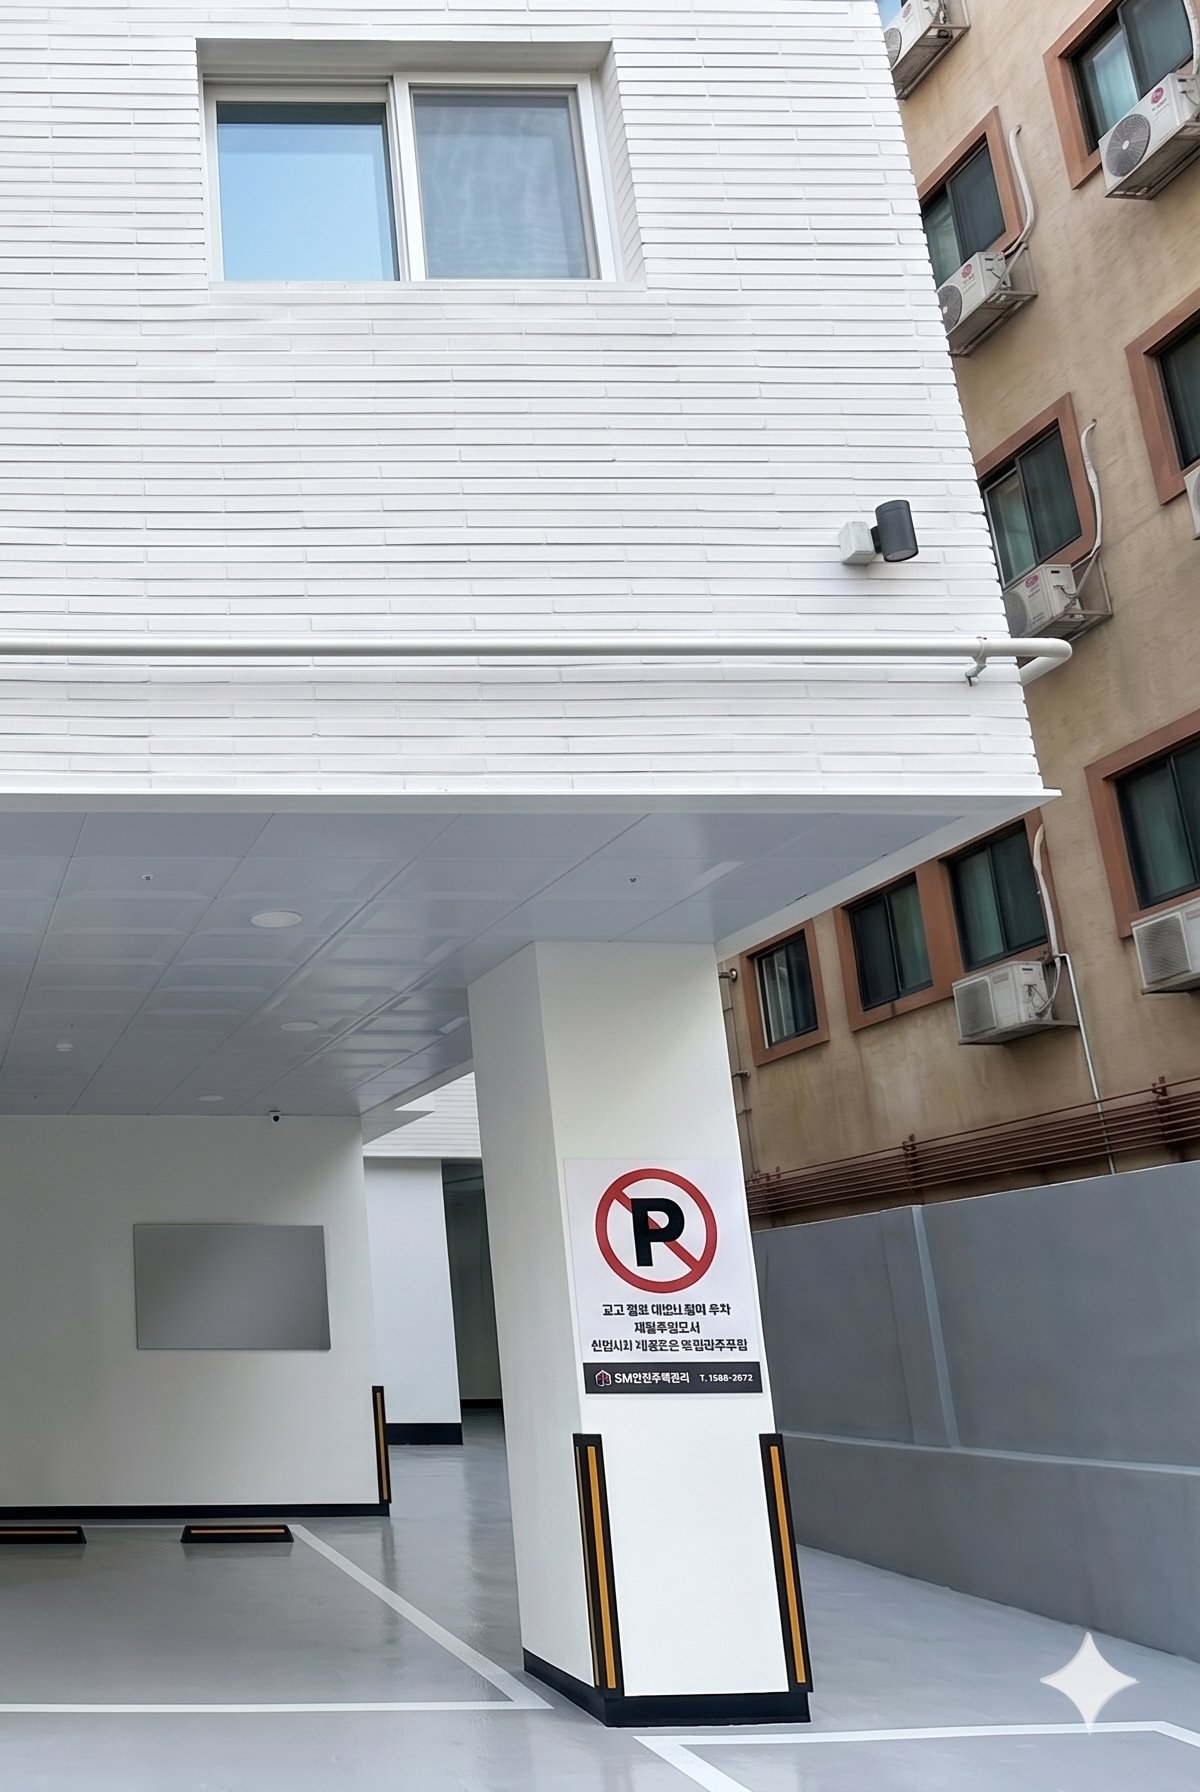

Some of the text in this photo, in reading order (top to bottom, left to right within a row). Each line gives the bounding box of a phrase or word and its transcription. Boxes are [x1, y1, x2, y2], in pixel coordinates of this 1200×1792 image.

[631, 1198, 685, 1266] P
[699, 1374, 707, 1382] T.
[708, 1374, 754, 1382] 1588-2672
